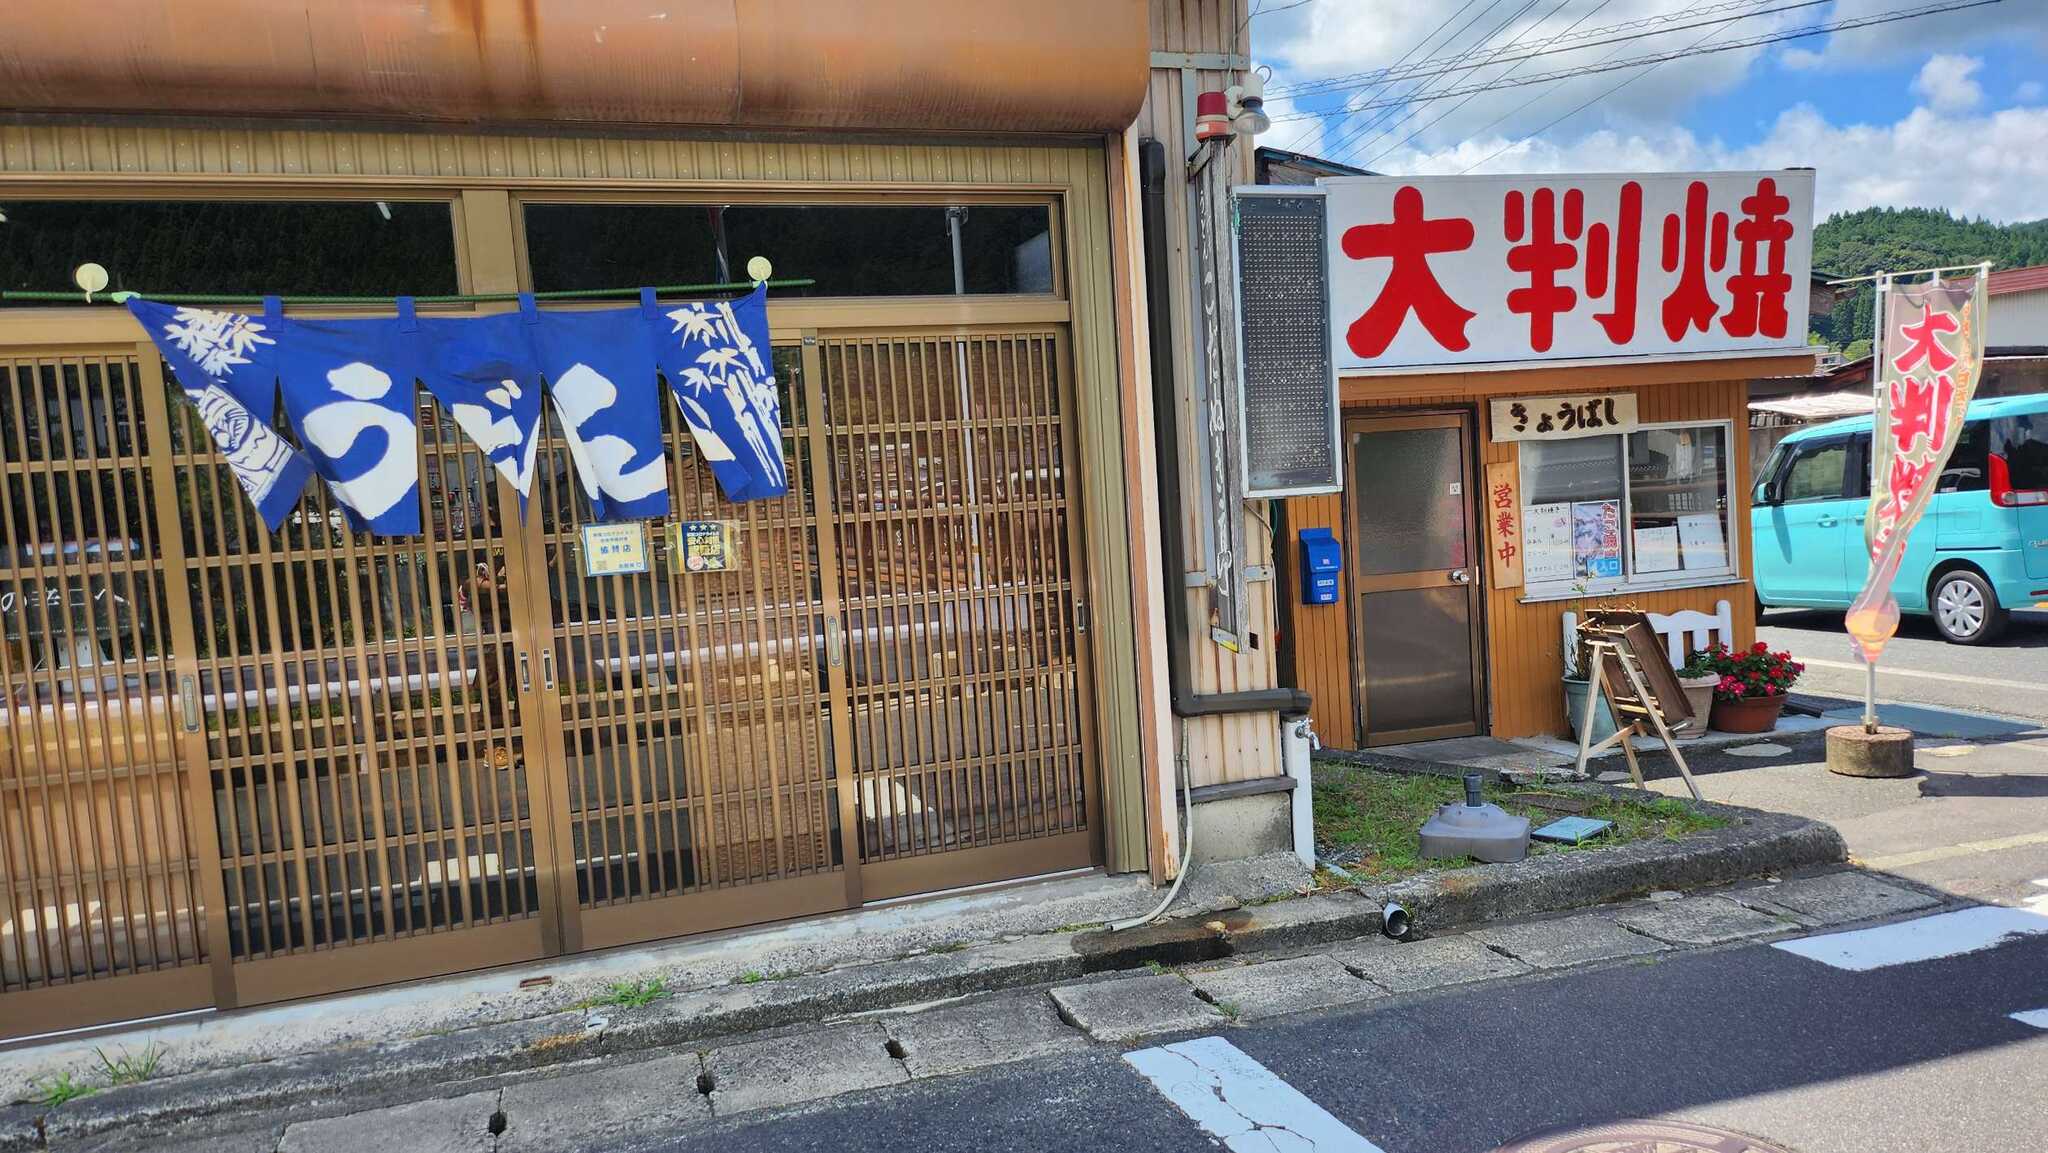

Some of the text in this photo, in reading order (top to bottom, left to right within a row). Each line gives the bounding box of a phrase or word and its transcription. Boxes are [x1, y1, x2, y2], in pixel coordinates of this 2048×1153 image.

[1341, 178, 1793, 359] 大判焼
[302, 362, 668, 520] うどん
[1510, 397, 1619, 433] きょうばし
[1493, 482, 1517, 568] 営業中
